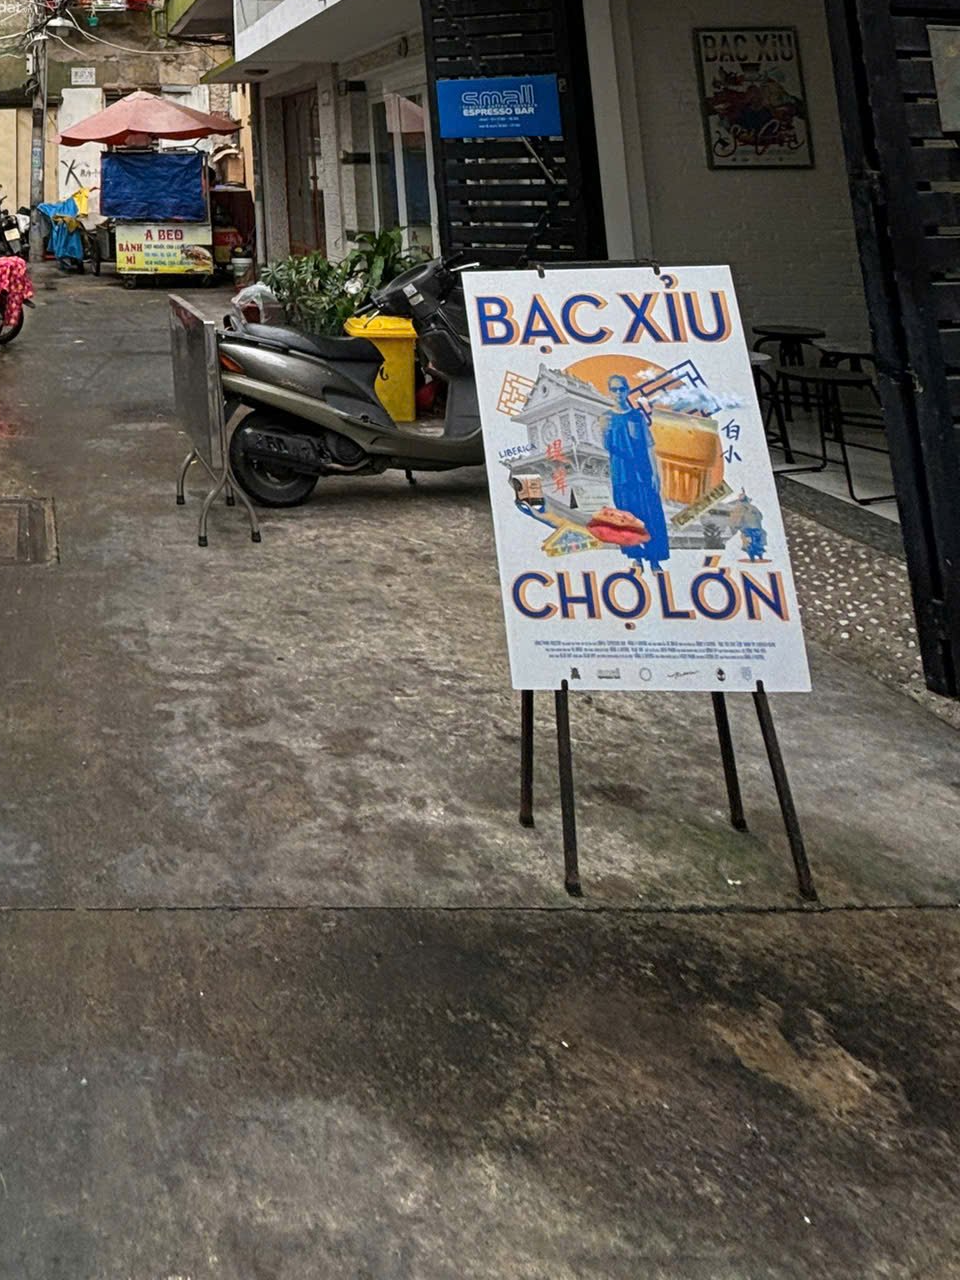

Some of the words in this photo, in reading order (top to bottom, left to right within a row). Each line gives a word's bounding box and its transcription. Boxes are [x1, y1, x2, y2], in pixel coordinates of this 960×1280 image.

[461, 84, 535, 105] small
[463, 107, 513, 117] ESPRESSO
[514, 106, 535, 116] BAR
[144, 229, 153, 241] A
[475, 293, 614, 354] BẠC
[617, 274, 733, 346] XỈU
[498, 442, 538, 459] LIBERICA
[511, 562, 650, 631] CHỢ
[658, 555, 791, 622] LỚN
